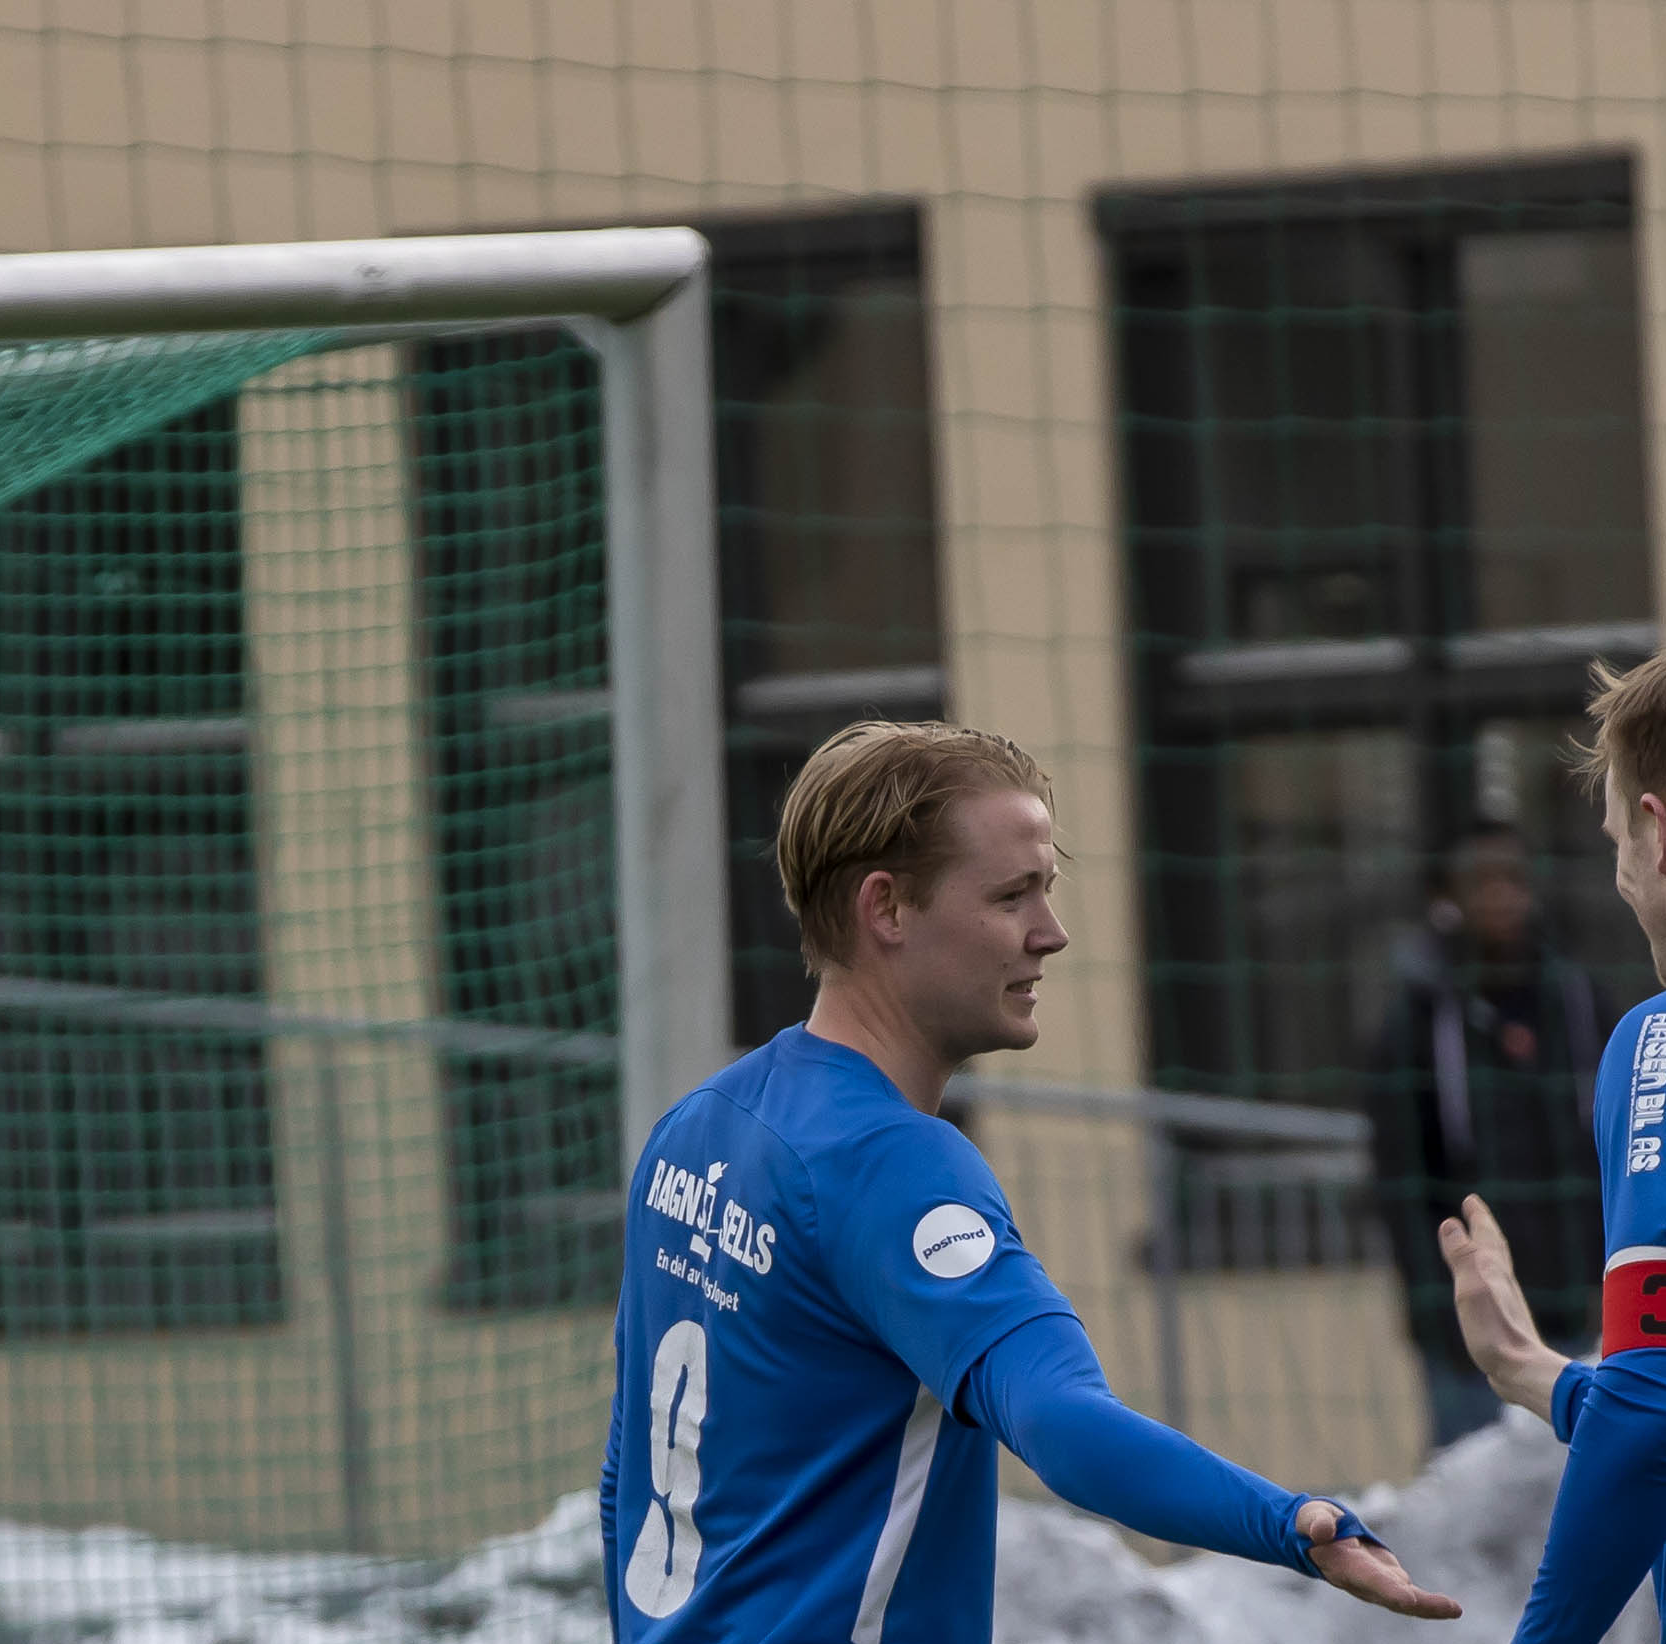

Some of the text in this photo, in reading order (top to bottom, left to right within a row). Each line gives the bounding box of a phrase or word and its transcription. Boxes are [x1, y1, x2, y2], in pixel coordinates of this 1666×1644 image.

[1633, 1093, 1666, 1131] BIL
[1631, 1136, 1661, 1173] AS
[646, 1158, 776, 1275] RAGN SELLS
[922, 1228, 986, 1260] postnord
[656, 1248, 669, 1271] En
[670, 1252, 687, 1279] del
[687, 1267, 701, 1285] av
[625, 1320, 706, 1618] 9
